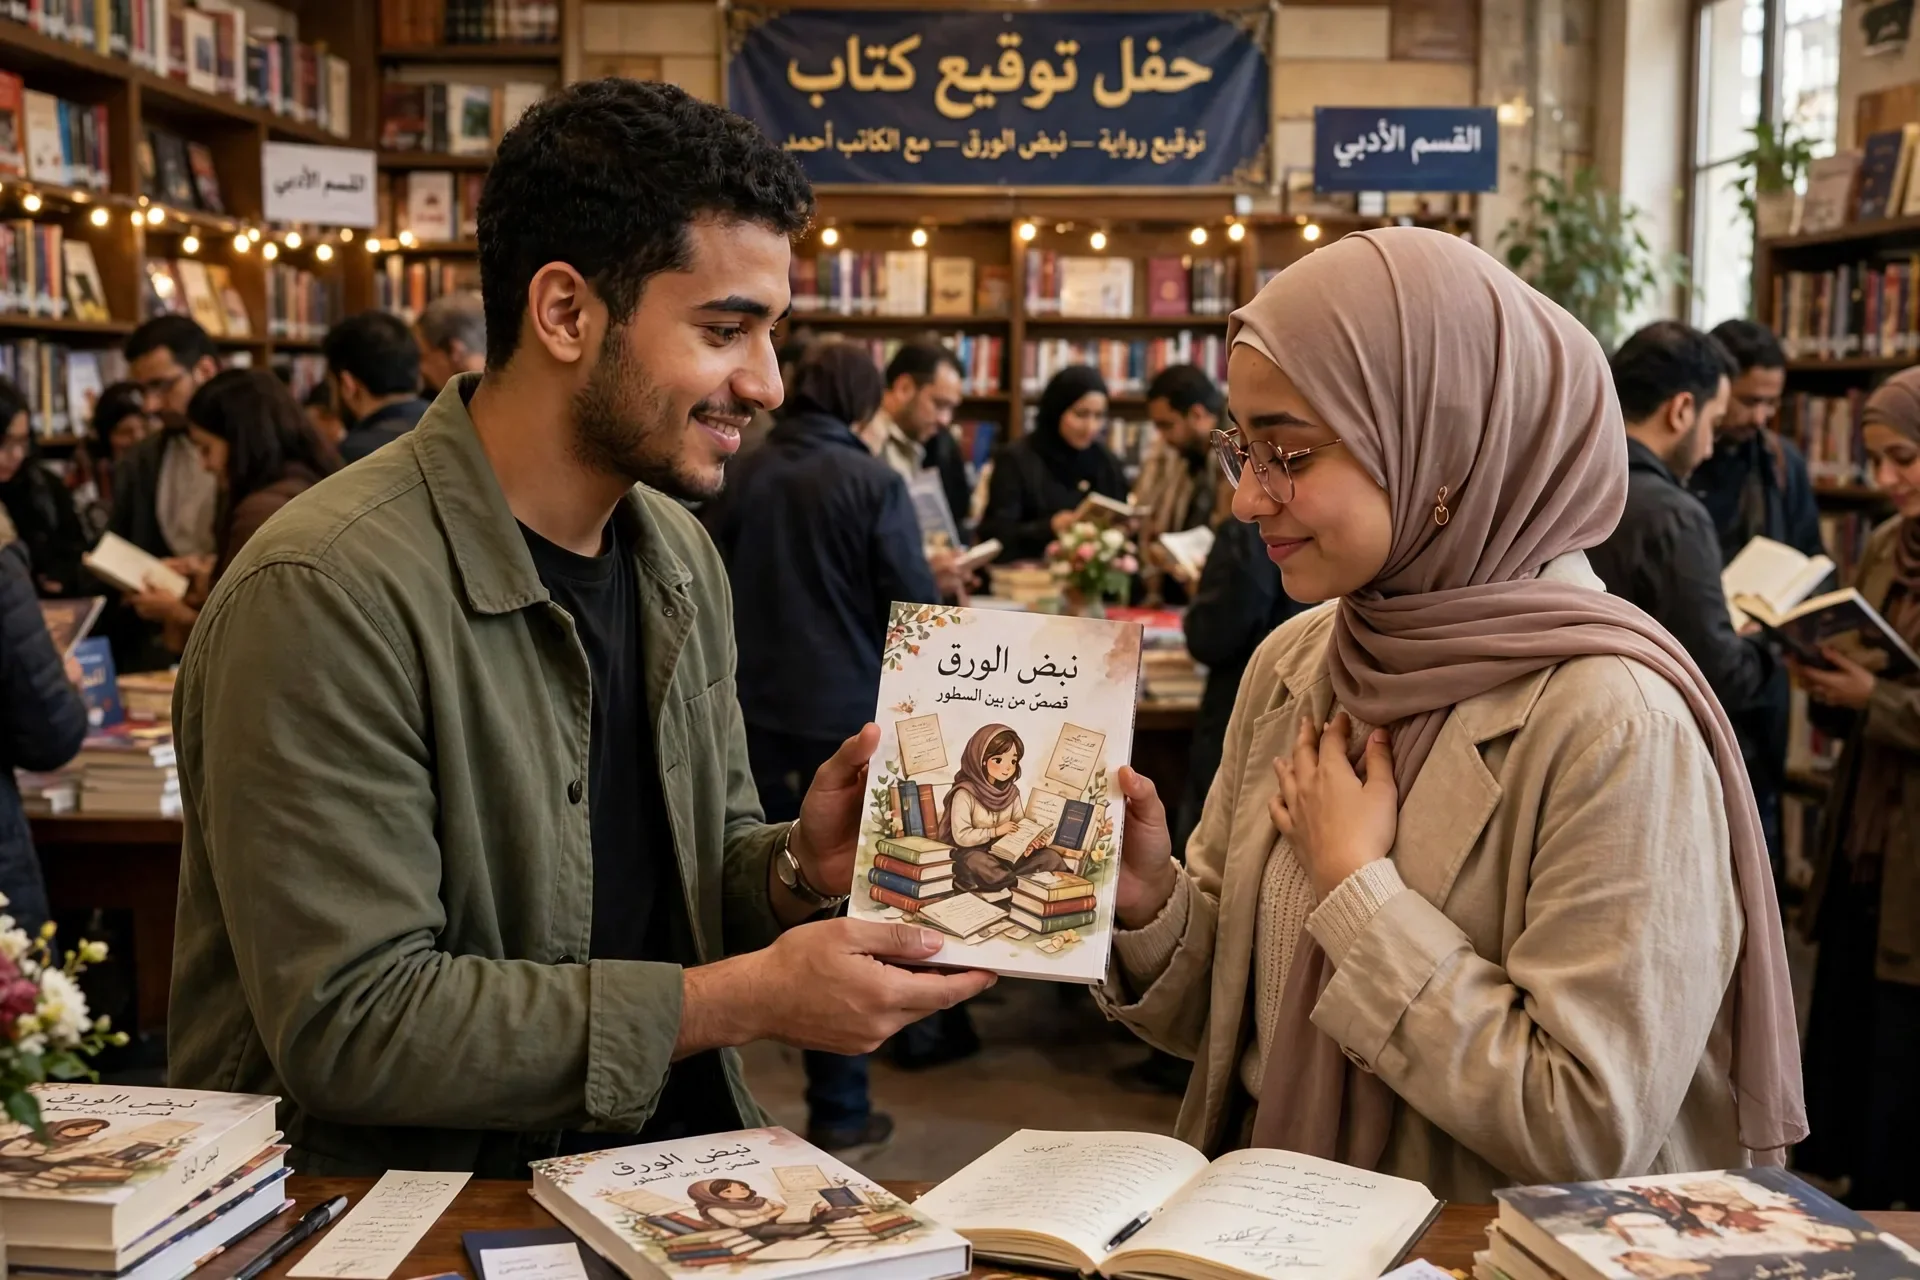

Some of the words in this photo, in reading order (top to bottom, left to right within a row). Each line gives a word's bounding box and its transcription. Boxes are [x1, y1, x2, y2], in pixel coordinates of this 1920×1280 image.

[787, 33, 922, 109] كتاب
[934, 32, 1079, 119] توقيع
[1093, 36, 1213, 108] حفل
[836, 127, 900, 160] الكاتب
[903, 136, 931, 164] مع
[961, 127, 1016, 159] الورق
[1018, 130, 1068, 160] نبض
[1098, 128, 1148, 159] رواية
[1151, 127, 1206, 164] توقيع
[1333, 118, 1405, 167] الأدبي
[1411, 124, 1482, 165] القسم
[937, 643, 1009, 681] الورق
[1017, 654, 1078, 687] نبض
[935, 686, 982, 703] السطور
[984, 694, 1004, 708] بين
[1008, 696, 1026, 709] من
[46, 1093, 130, 1106] الورق
[128, 1099, 198, 1111] نبض
[612, 1152, 684, 1176] الورق
[694, 1143, 752, 1164] نبض
